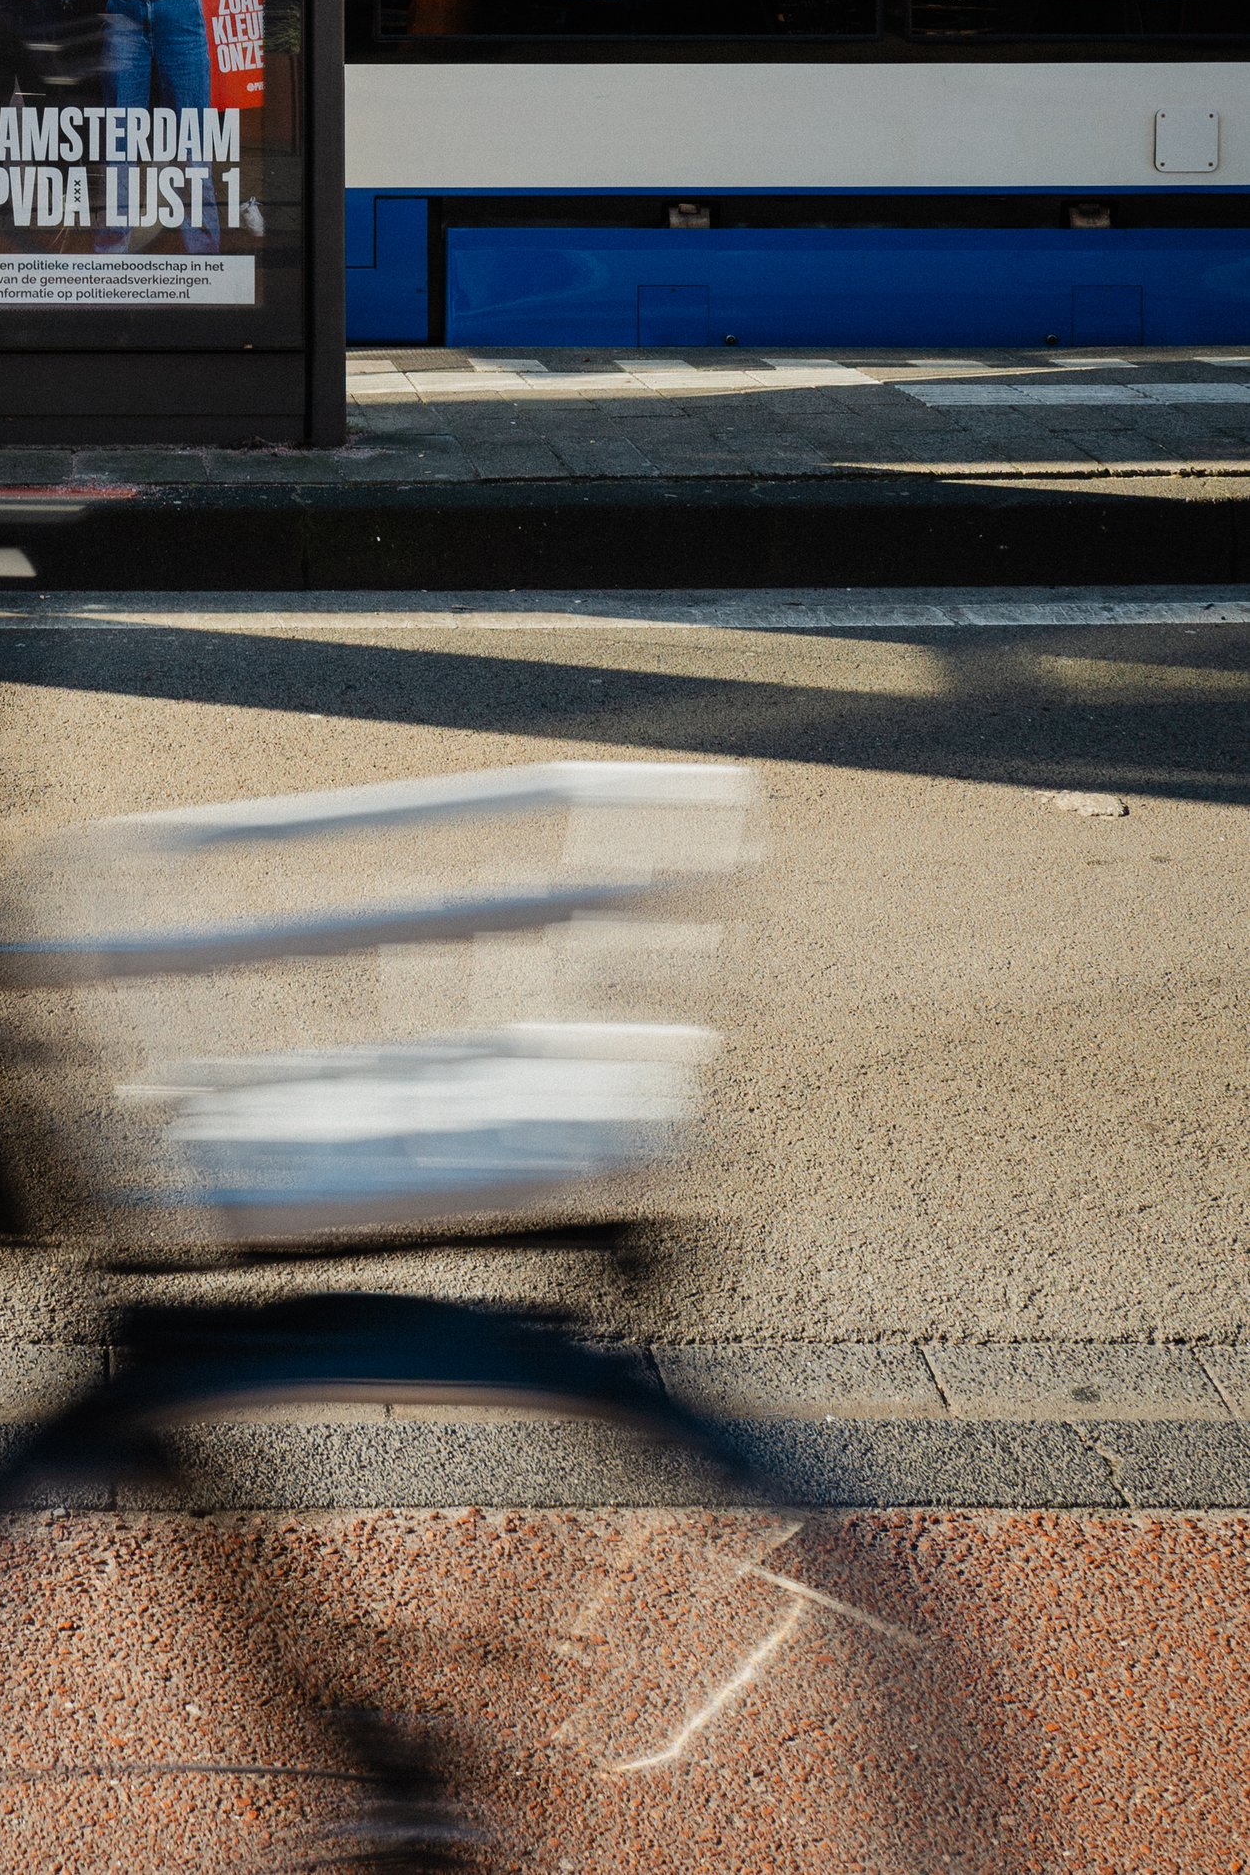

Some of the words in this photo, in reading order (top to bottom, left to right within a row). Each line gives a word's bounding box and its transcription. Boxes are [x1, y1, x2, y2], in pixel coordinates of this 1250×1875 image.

[217, 39, 264, 74] ONZE
[105, 166, 209, 229] LIJST
[221, 167, 240, 228] 1
[17, 260, 69, 273] politieke
[72, 260, 187, 273] reclameboodschap
[191, 261, 201, 271] in
[204, 261, 224, 272] het
[21, 274, 37, 285] de
[40, 274, 212, 287] gemeenteraadsverkiezingen.
[57, 290, 73, 300] op
[76, 288, 190, 300] politiekereclame.nl
